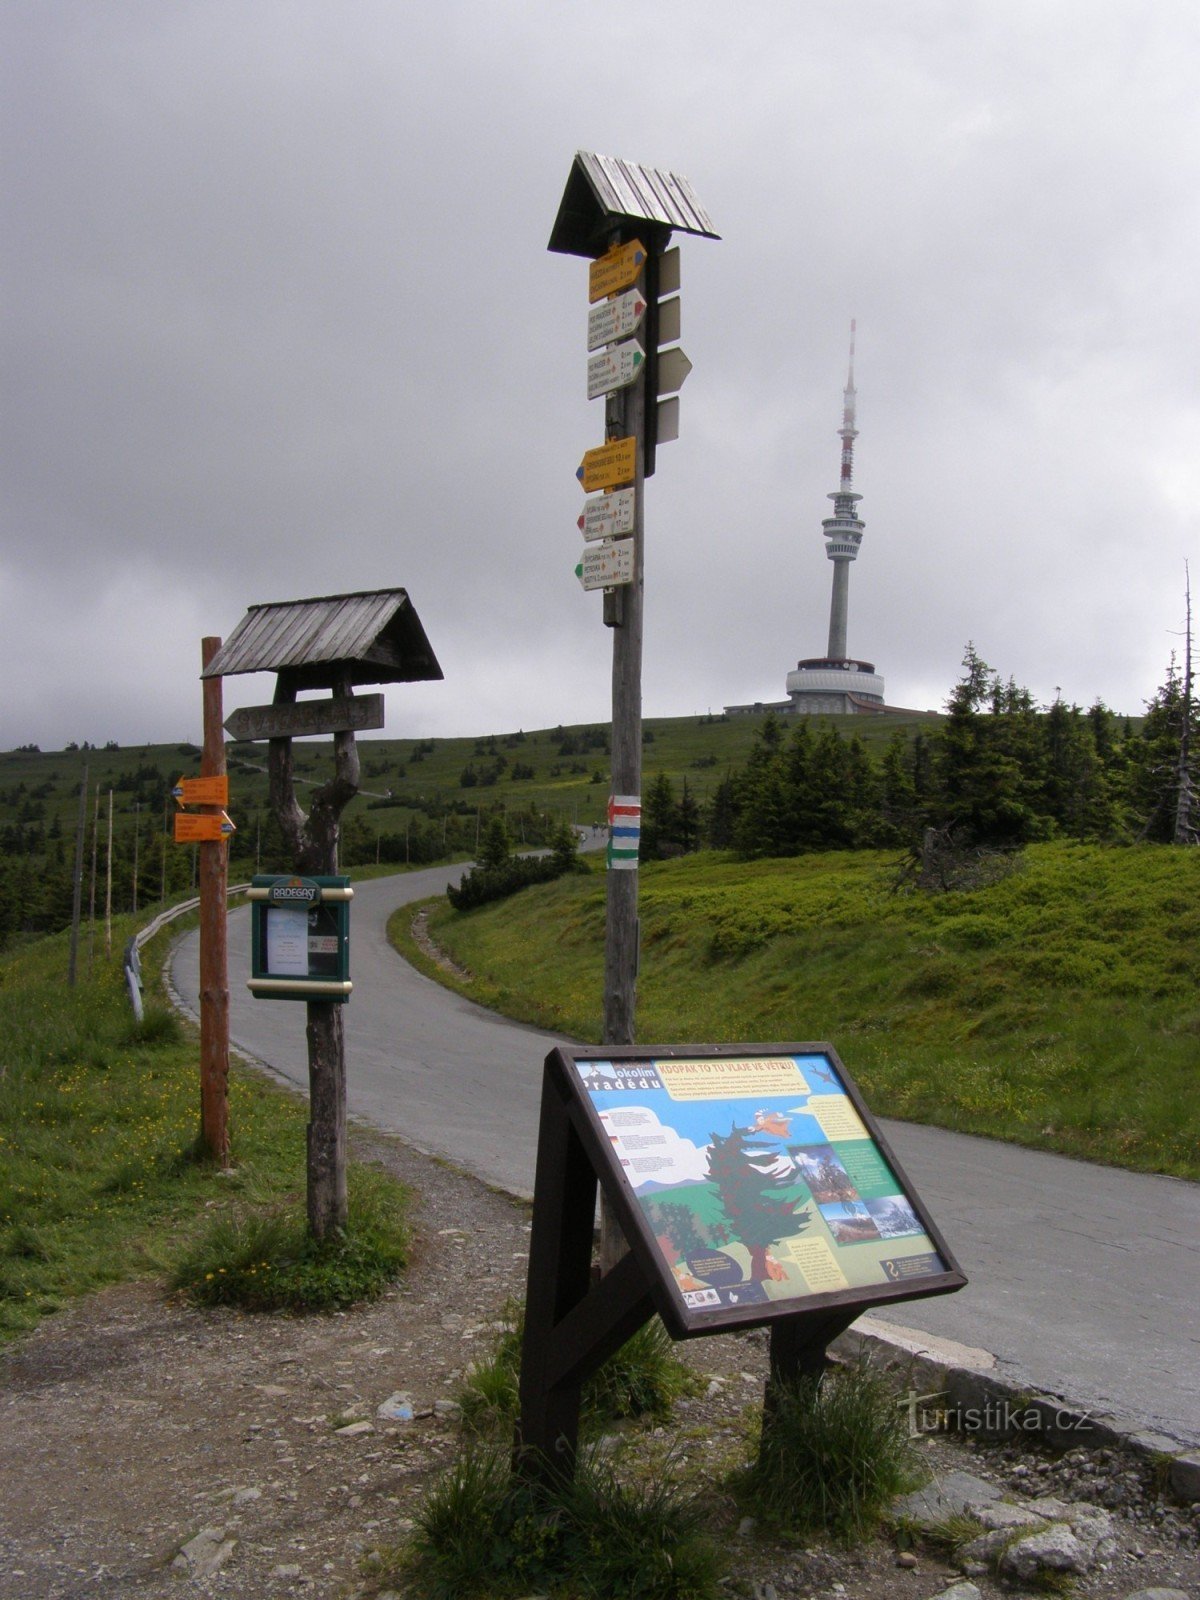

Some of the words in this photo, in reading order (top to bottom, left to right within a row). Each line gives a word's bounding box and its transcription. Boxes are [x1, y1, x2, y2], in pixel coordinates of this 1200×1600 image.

[273, 888, 316, 901] RADEGAST
[616, 1068, 656, 1078] okolím
[659, 1064, 698, 1074] KDOPAK
[712, 1063, 725, 1072] TU
[725, 1062, 752, 1072] VLAJE
[752, 1062, 764, 1071] VE
